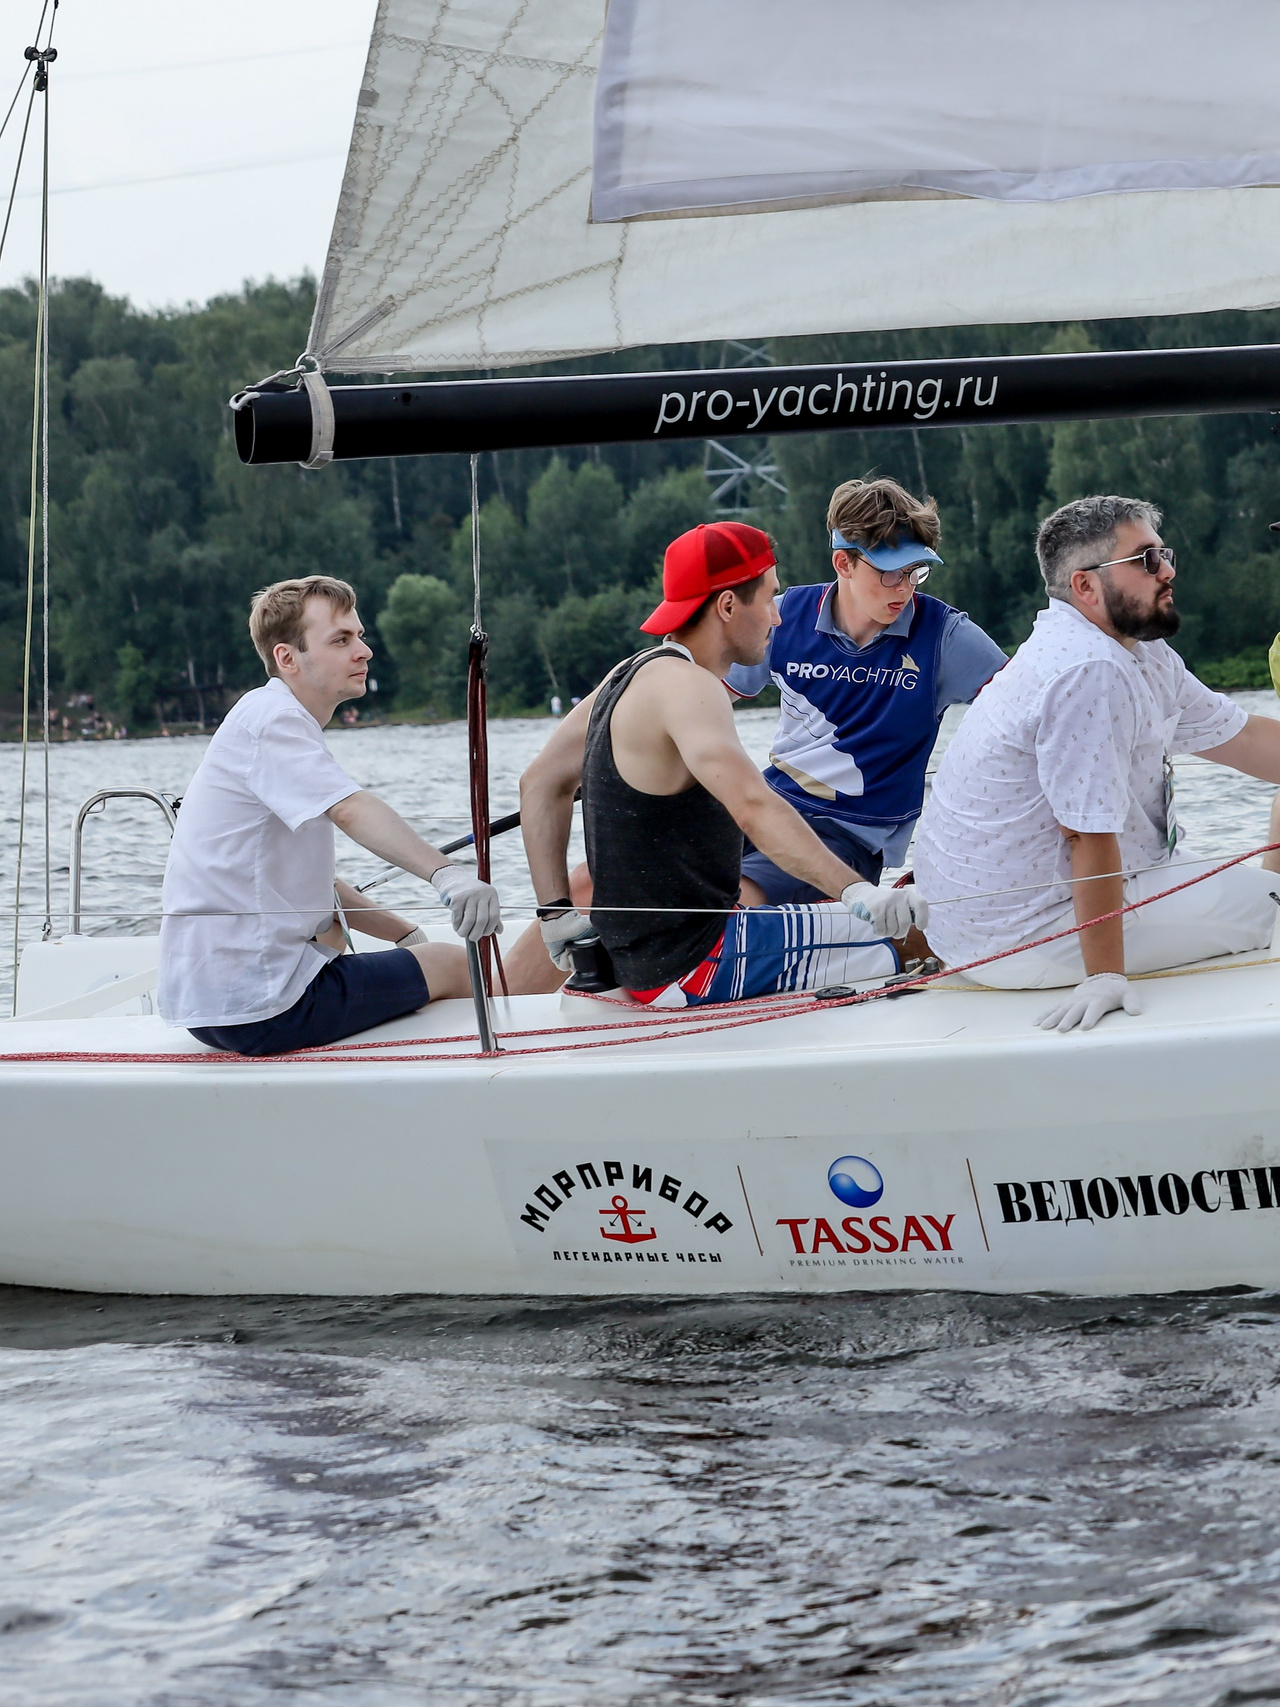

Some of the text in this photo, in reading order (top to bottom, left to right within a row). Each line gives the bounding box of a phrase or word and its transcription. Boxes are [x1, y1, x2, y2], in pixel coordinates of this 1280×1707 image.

[653, 371, 999, 433] pro-yachting.ru
[519, 1160, 734, 1234] МОРПРИБОР
[775, 1214, 957, 1255] TASSAY
[552, 1250, 723, 1264] ЛЕГЕНДАРНЫЕ ЧАСЫ
[789, 1255, 966, 1268] PREMIUM DRINKING WATER
